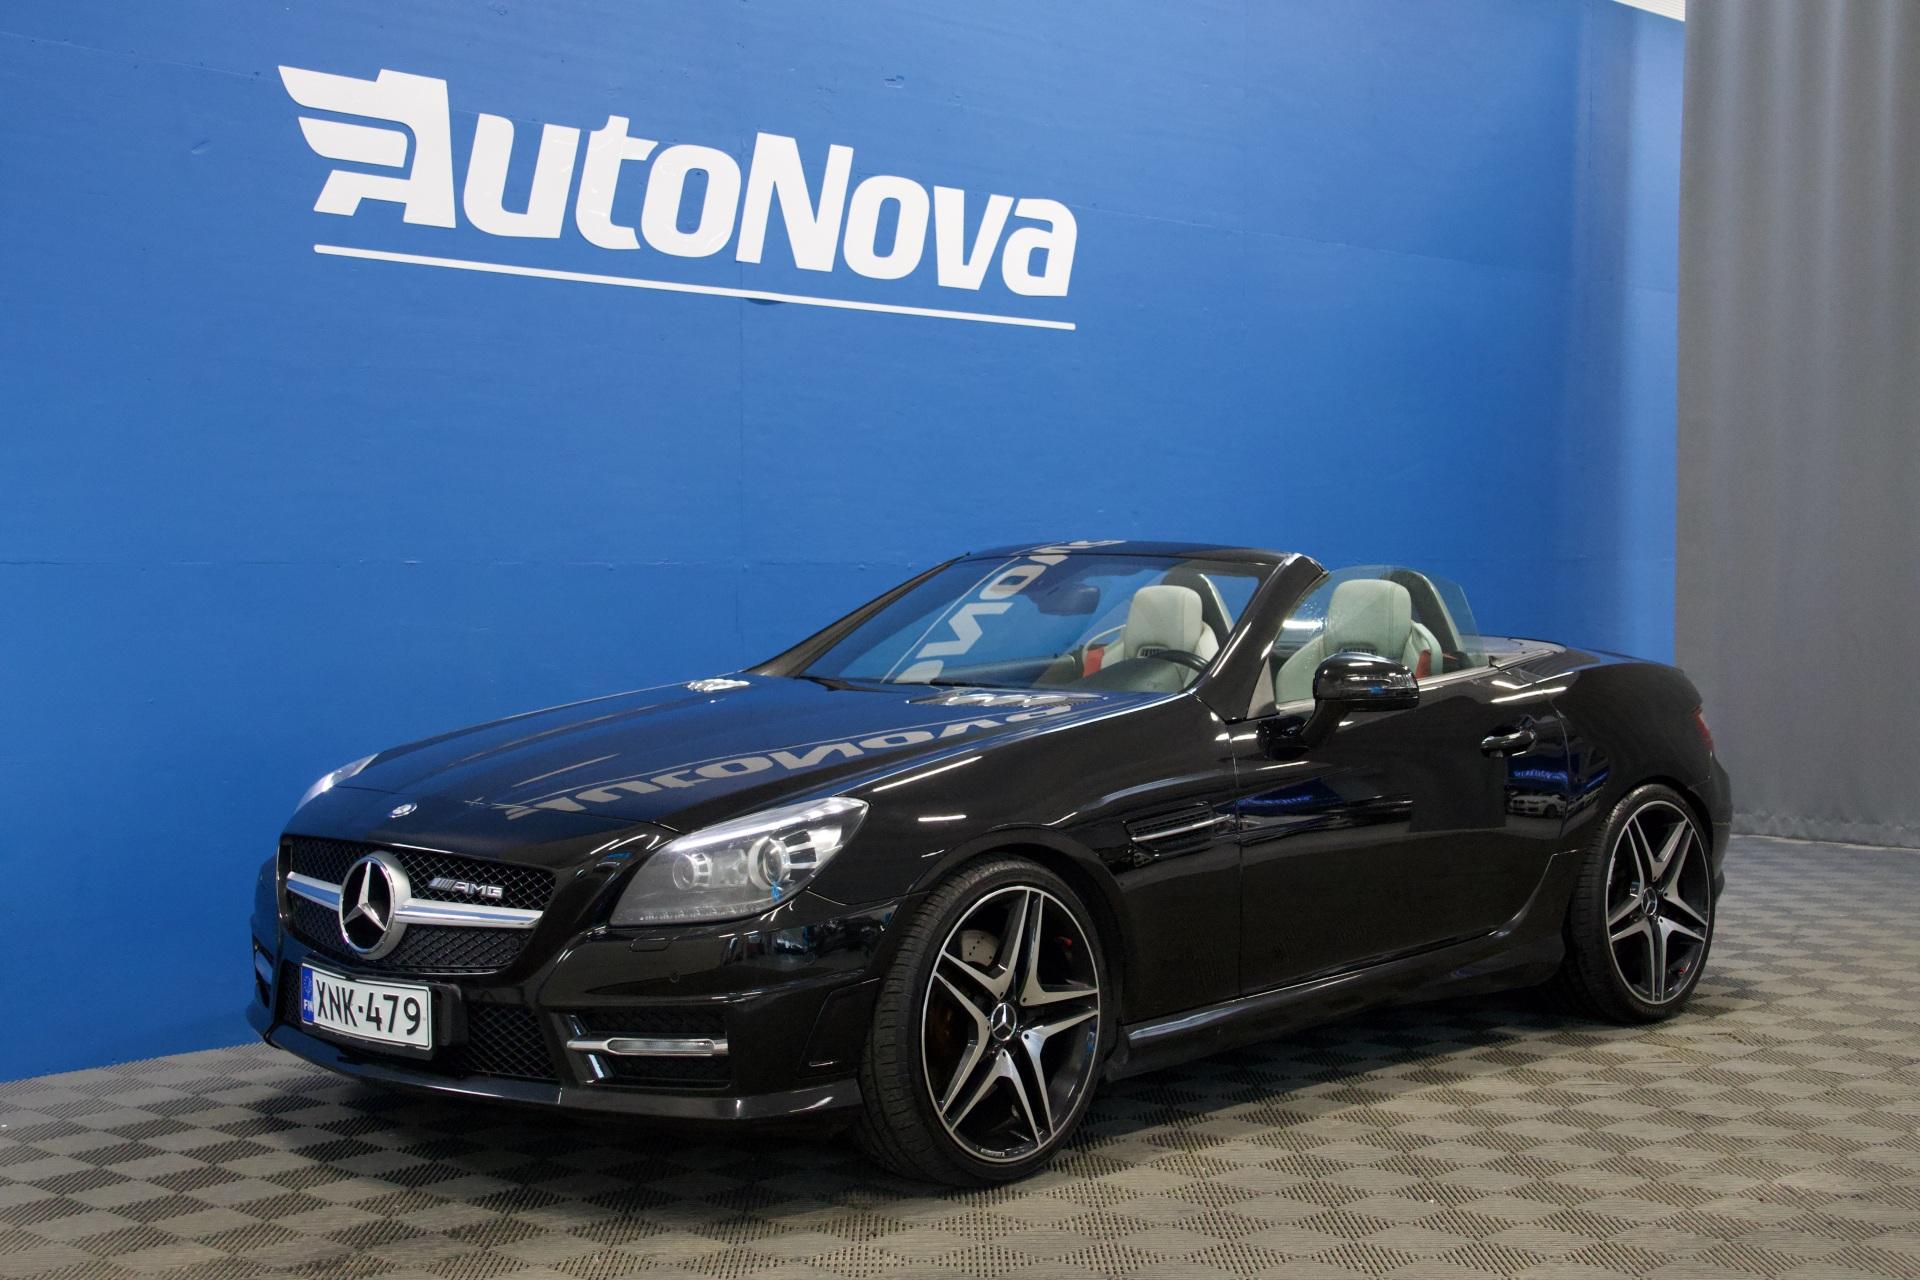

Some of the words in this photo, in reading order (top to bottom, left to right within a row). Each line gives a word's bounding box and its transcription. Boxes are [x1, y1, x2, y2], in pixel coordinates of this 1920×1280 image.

[279, 66, 1077, 297] AutoNova
[451, 880, 504, 899] AMG
[316, 979, 420, 1036] XNK-479
